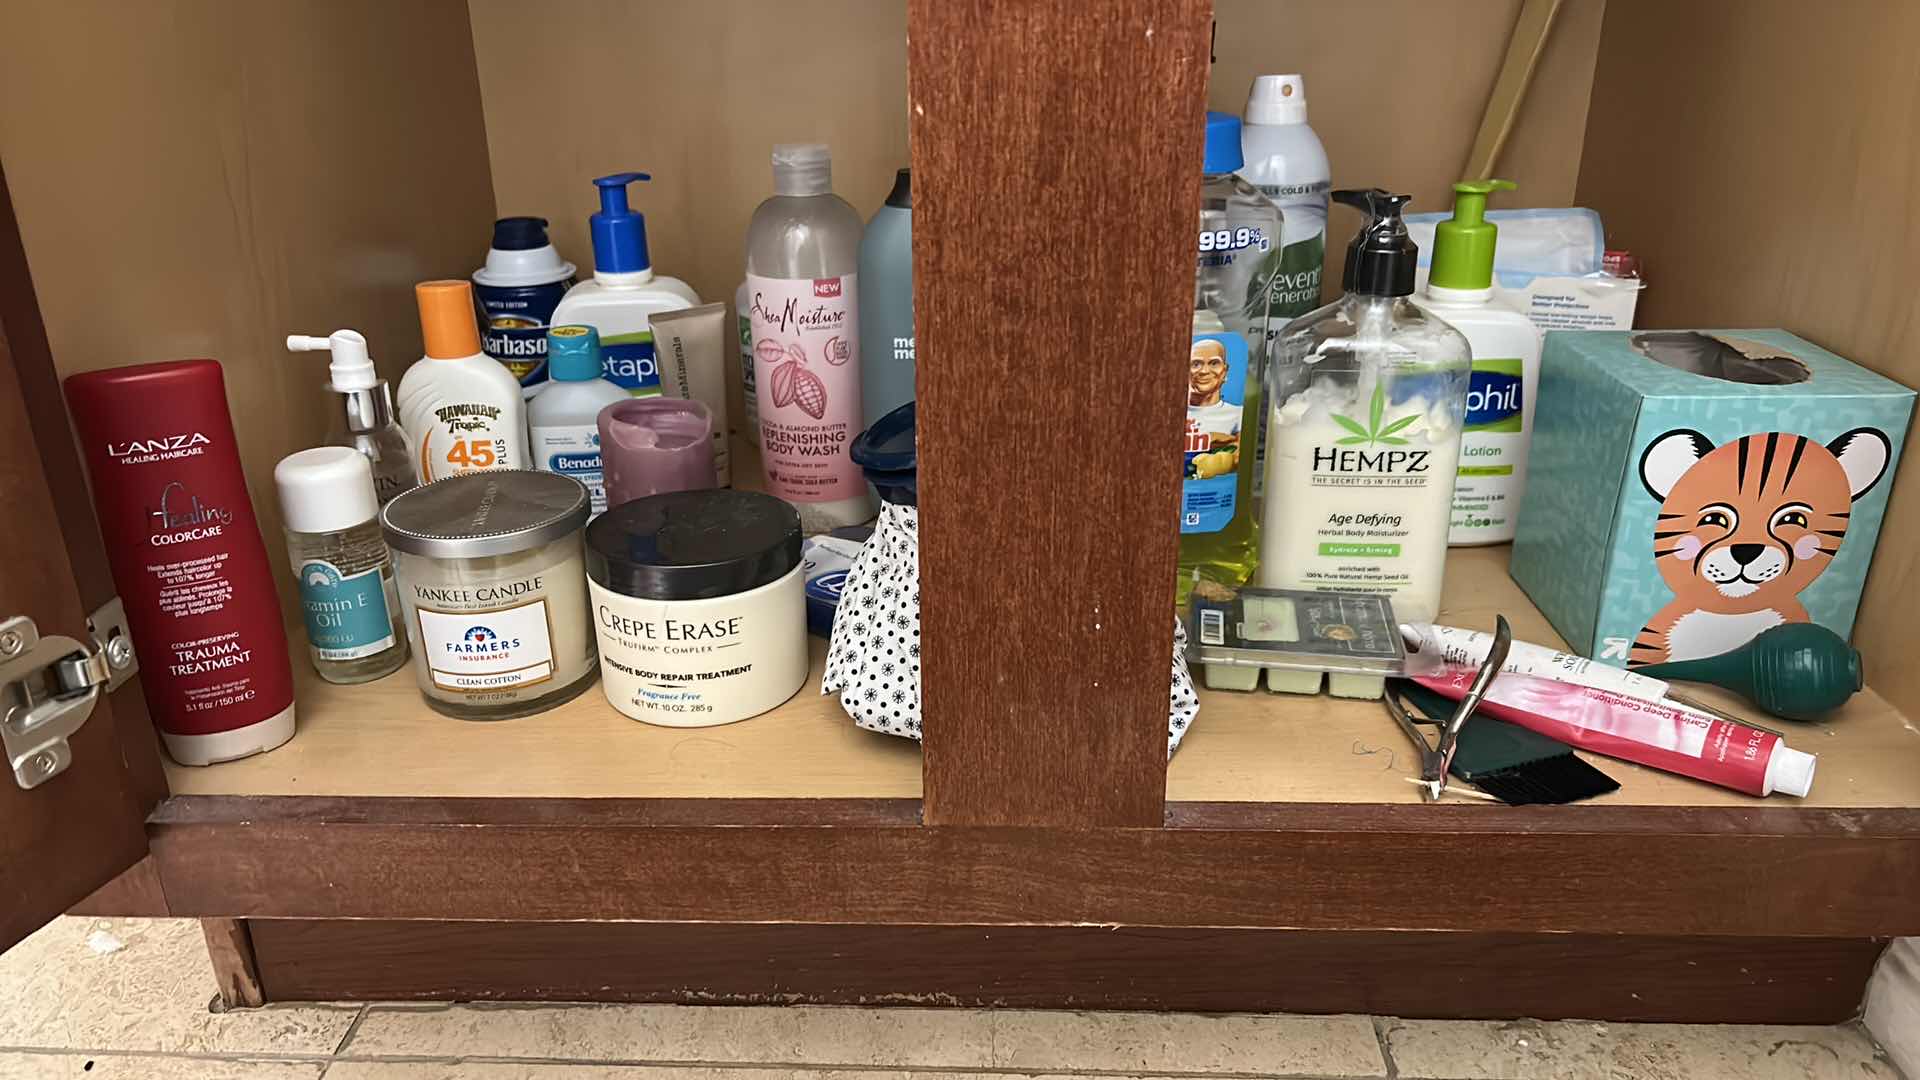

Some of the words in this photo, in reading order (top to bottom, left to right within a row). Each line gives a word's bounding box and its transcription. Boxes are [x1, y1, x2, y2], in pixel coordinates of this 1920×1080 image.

[1281, 186, 1304, 196] COLD
[814, 282, 840, 293] NEW
[435, 403, 502, 421] HAWAIIAN
[762, 425, 846, 445] REPLENISHING
[785, 424, 820, 433] ALMOND
[121, 453, 160, 465] HEALING
[160, 447, 204, 461] HAIRCARE
[446, 440, 496, 467] 45
[495, 438, 507, 465] PLUS
[766, 440, 794, 456] BODY
[798, 444, 840, 457] WASH
[1463, 445, 1502, 457] Lotion
[558, 454, 603, 471] Benad
[1312, 446, 1430, 473] HEMPZ
[1312, 477, 1327, 485] THE
[1330, 477, 1360, 485] SECRET
[1328, 513, 1353, 526] Age
[1355, 513, 1402, 526] Defying
[1345, 529, 1365, 538] Body
[1366, 529, 1409, 537] Moisturizer
[175, 573, 195, 583] 107%
[195, 570, 216, 581] longer
[414, 584, 472, 602] YANKEE
[475, 576, 543, 602] CANDLE
[212, 593, 232, 604] 107%
[357, 592, 369, 607] E
[316, 611, 342, 628] Oil
[176, 641, 241, 663] TRAUMA
[446, 638, 521, 653] FARMERS
[169, 649, 251, 676] TREATMENT
[459, 652, 510, 662] INSURANCE
[604, 656, 634, 675] INTENSIVE
[634, 670, 658, 680] BODY
[660, 672, 694, 681] REPAIR
[696, 664, 753, 681] TREATMENT
[456, 678, 482, 686] CLEAN
[484, 674, 521, 685] COTTON
[219, 696, 234, 706] 150
[637, 688, 680, 701] Fragrance
[680, 691, 701, 700] Free
[631, 699, 645, 709] NET
[661, 703, 671, 712] 10
[690, 703, 707, 713] 285
[707, 705, 713, 714] g
[1643, 705, 1672, 720] Deep
[1674, 712, 1709, 730] Caring
